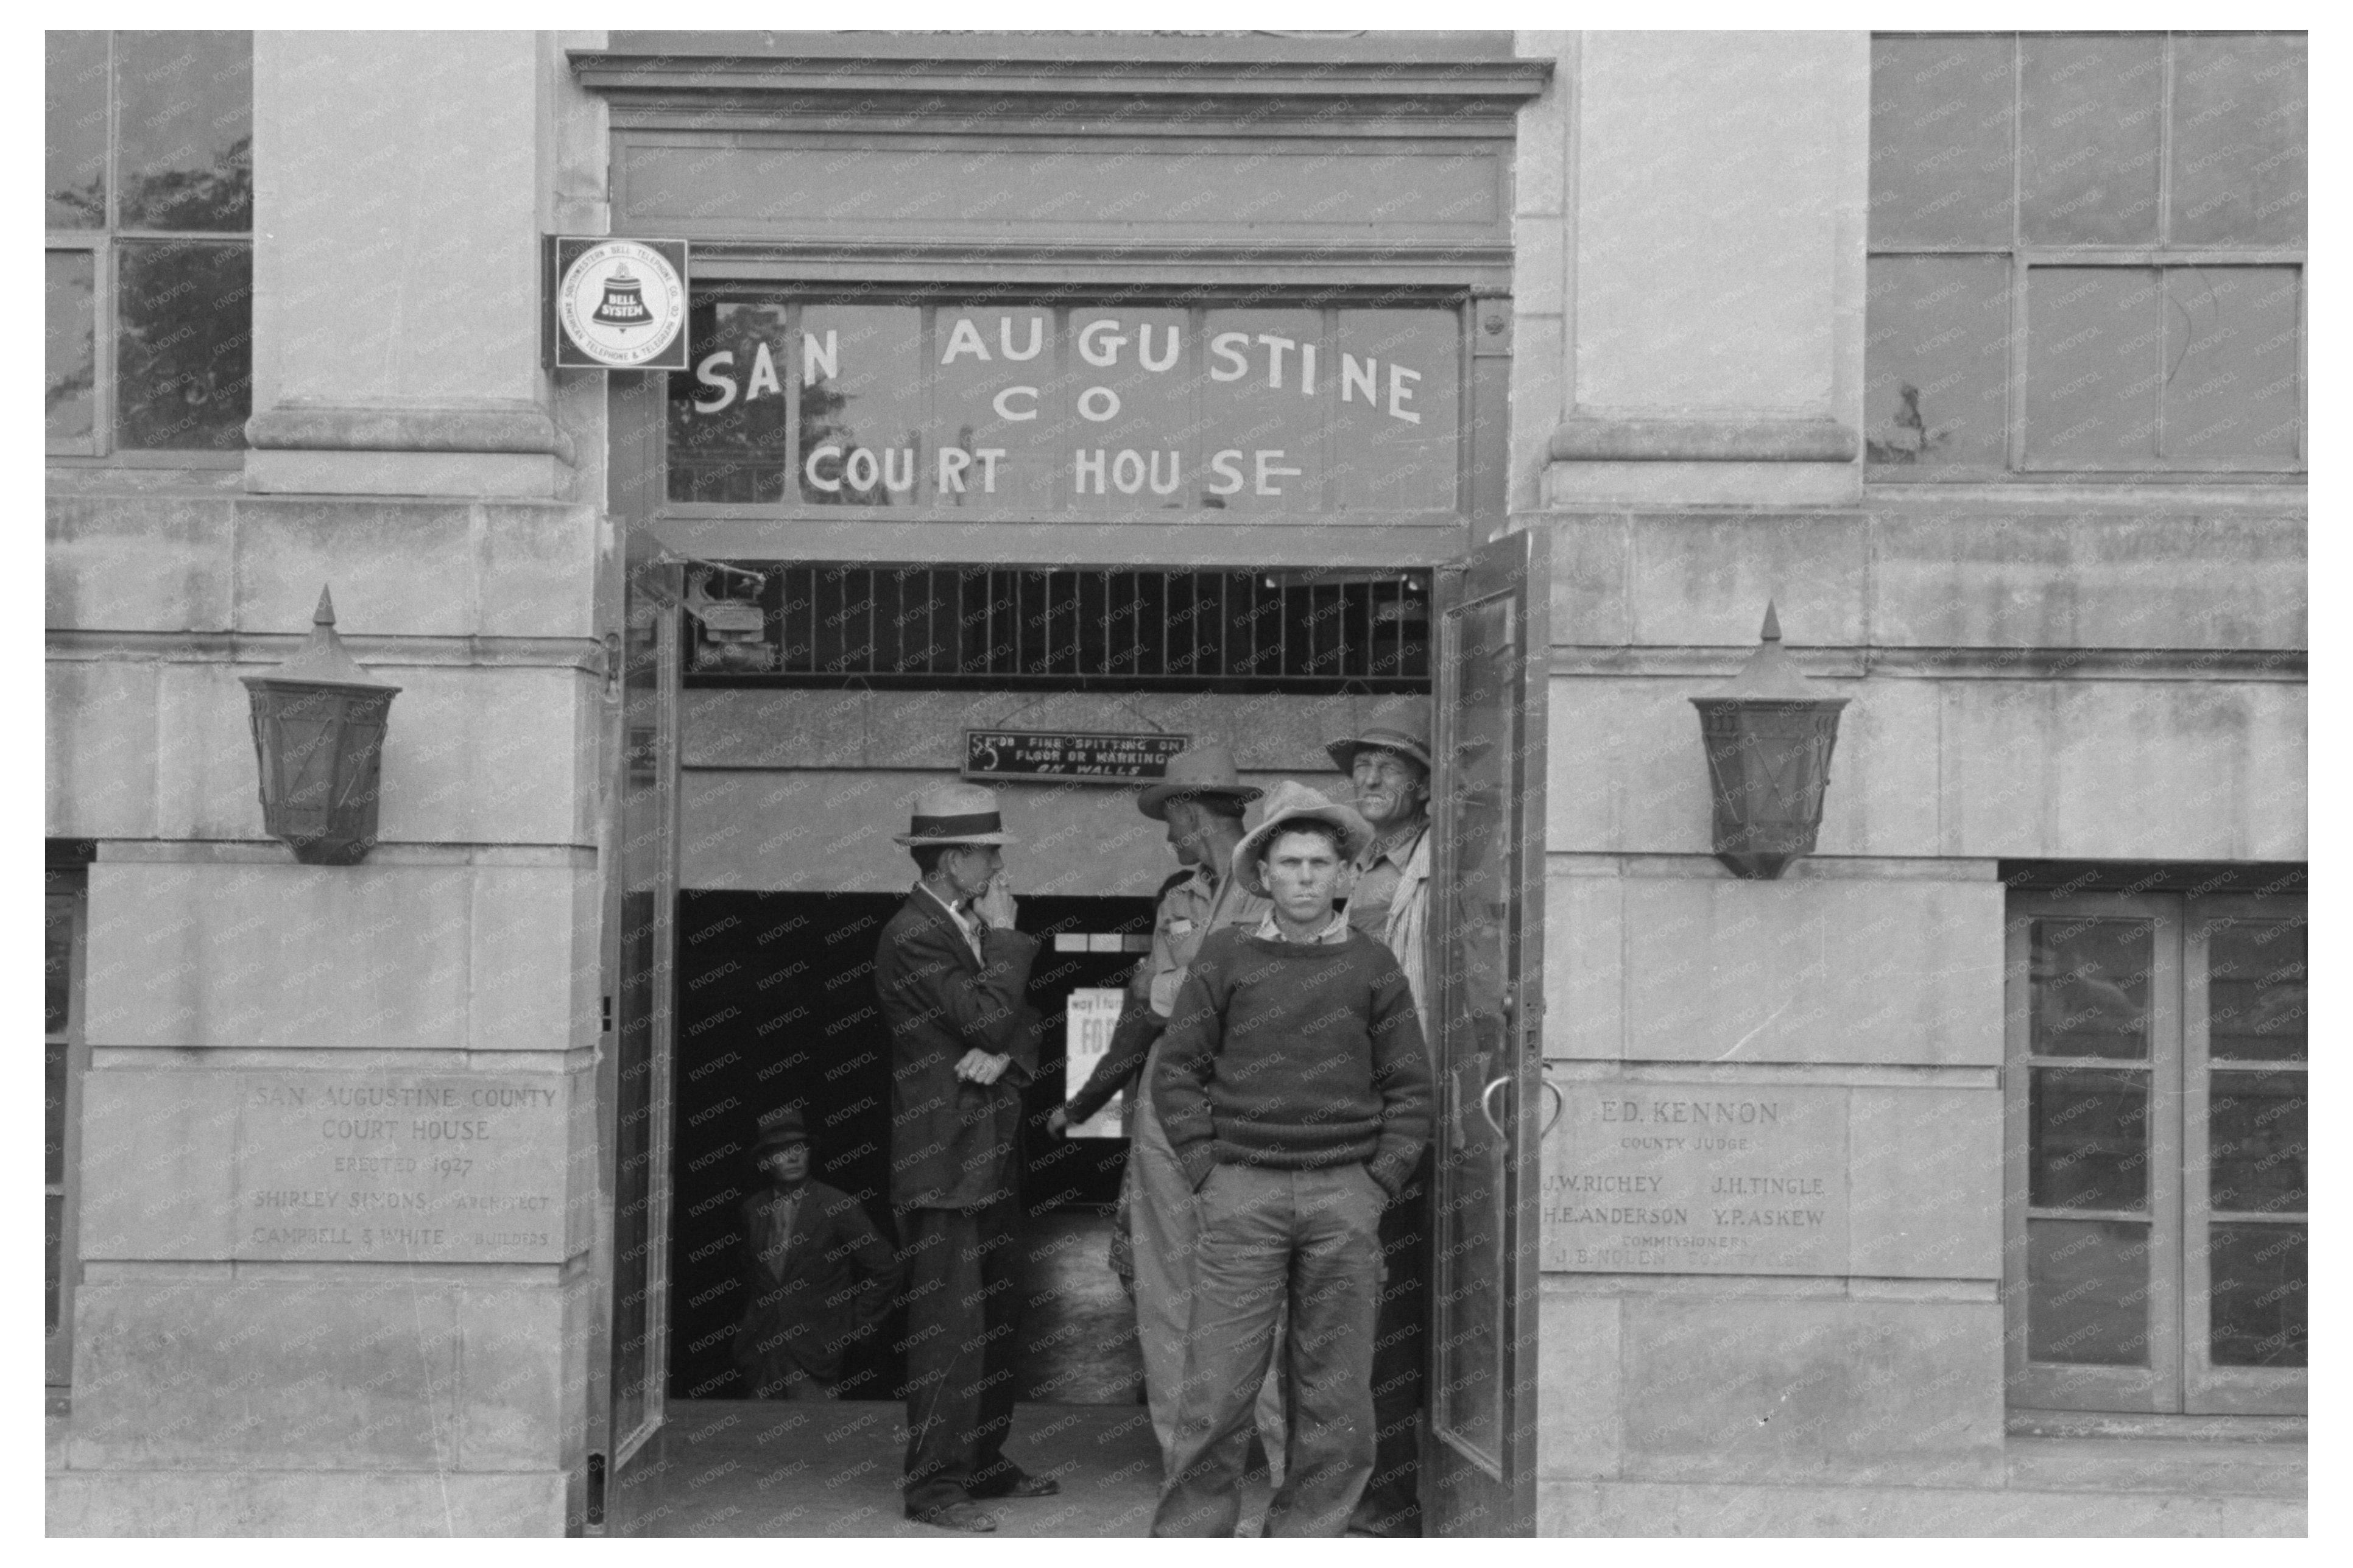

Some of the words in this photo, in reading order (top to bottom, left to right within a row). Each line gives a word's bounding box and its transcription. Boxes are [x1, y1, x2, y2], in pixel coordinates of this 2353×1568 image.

[638, 248, 672, 282] TELEPHONE
[609, 294, 637, 304] BELL
[602, 304, 643, 317] SYSTEM
[586, 340, 630, 360] TELEPHONE
[695, 329, 838, 414] SAN
[940, 317, 1422, 424] AUGUSTINE
[806, 445, 1006, 493] COURT
[1076, 449, 1302, 496] HOUSE
[1075, 738, 1146, 751] SPITTING
[1159, 740, 1180, 751] ON
[1015, 750, 1060, 762] FLOOR
[1068, 751, 1086, 762] OR
[1097, 753, 1166, 765] MARKING
[1037, 764, 1065, 774] ON
[1076, 764, 1141, 776] WALLS
[256, 1087, 305, 1106] SAN
[325, 1088, 456, 1108] AUGUSTINE
[471, 1089, 557, 1108] COUNTY
[1602, 1101, 1644, 1122] ED.
[1653, 1101, 1779, 1123] KENNON
[322, 1120, 398, 1140] COURT
[412, 1120, 490, 1141] HOUSE
[1621, 1136, 1685, 1150] COUNTY
[1694, 1137, 1748, 1151] JUDGE
[334, 1158, 417, 1173] ERECTED
[433, 1159, 474, 1178] 1927
[253, 1191, 339, 1209] SHIRLEY
[253, 1228, 351, 1245] CAMPBELL
[379, 1229, 444, 1246] WHITE
